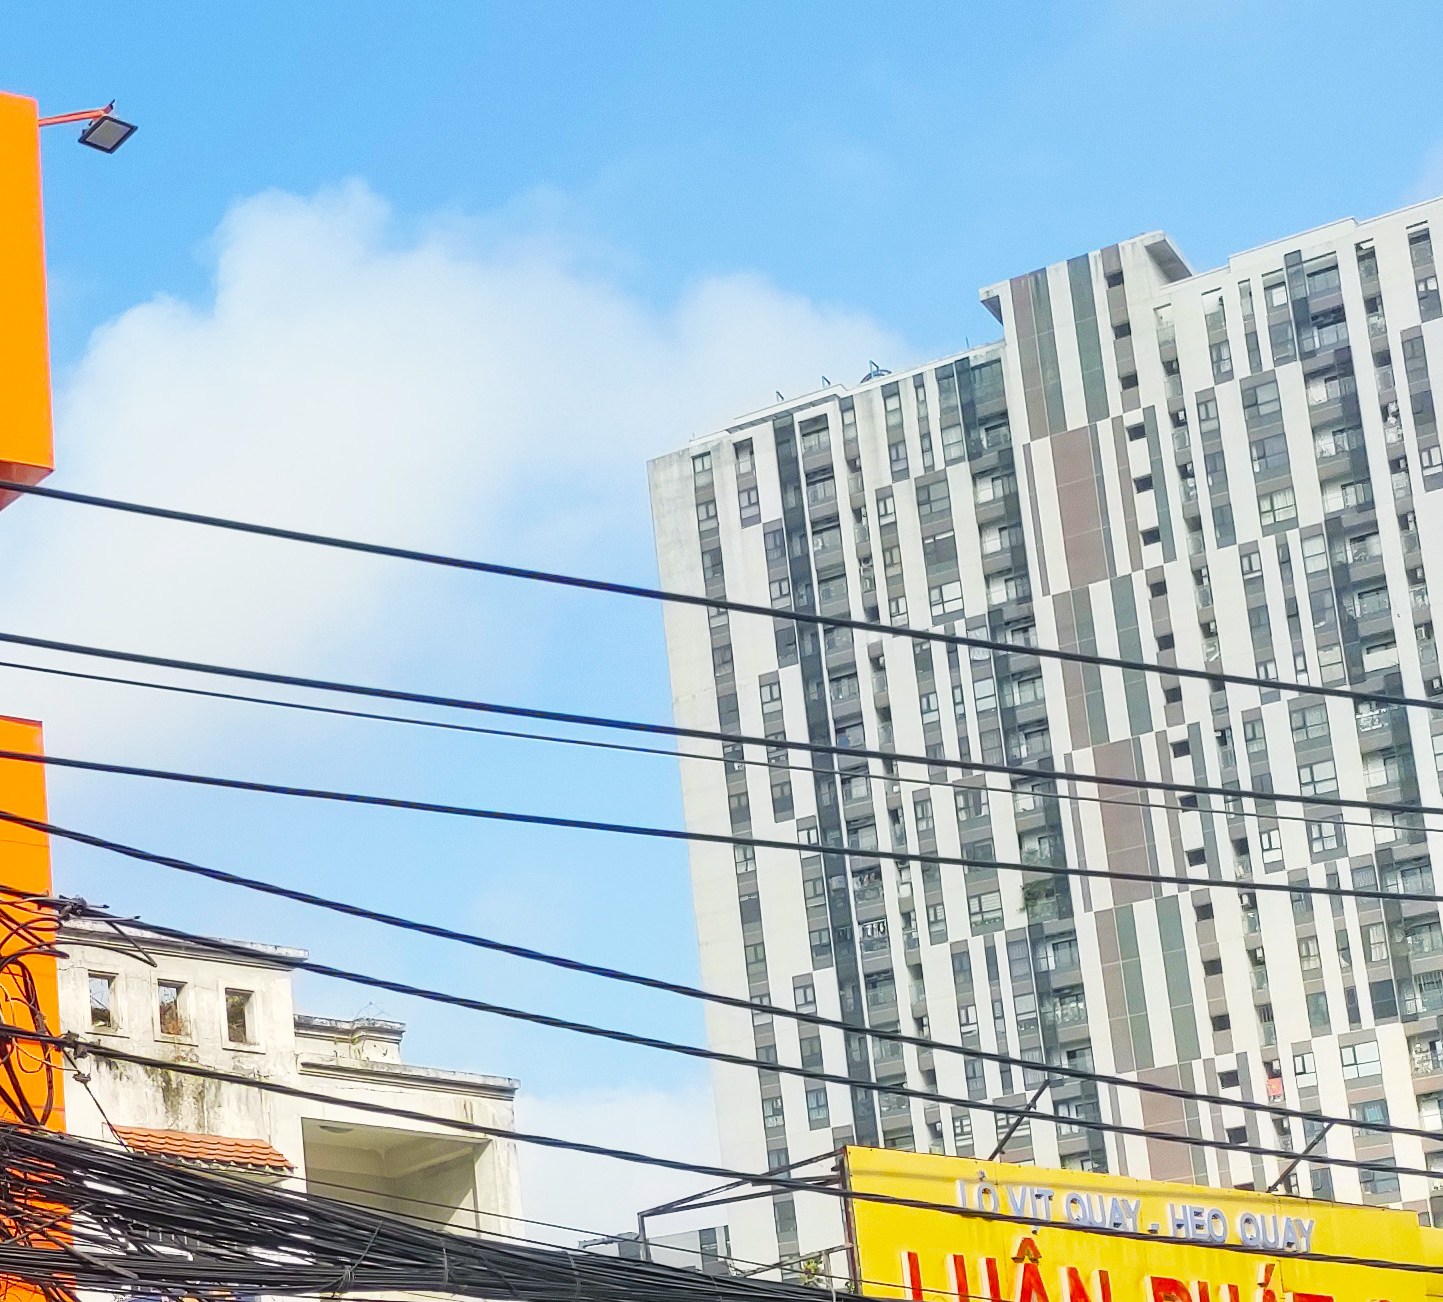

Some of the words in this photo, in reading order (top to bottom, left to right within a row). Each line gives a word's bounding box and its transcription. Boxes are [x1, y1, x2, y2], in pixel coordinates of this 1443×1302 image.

[1065, 1192, 1141, 1234] QUAY
[1168, 1202, 1228, 1243] HEO
[1240, 1213, 1315, 1253] QUAY
